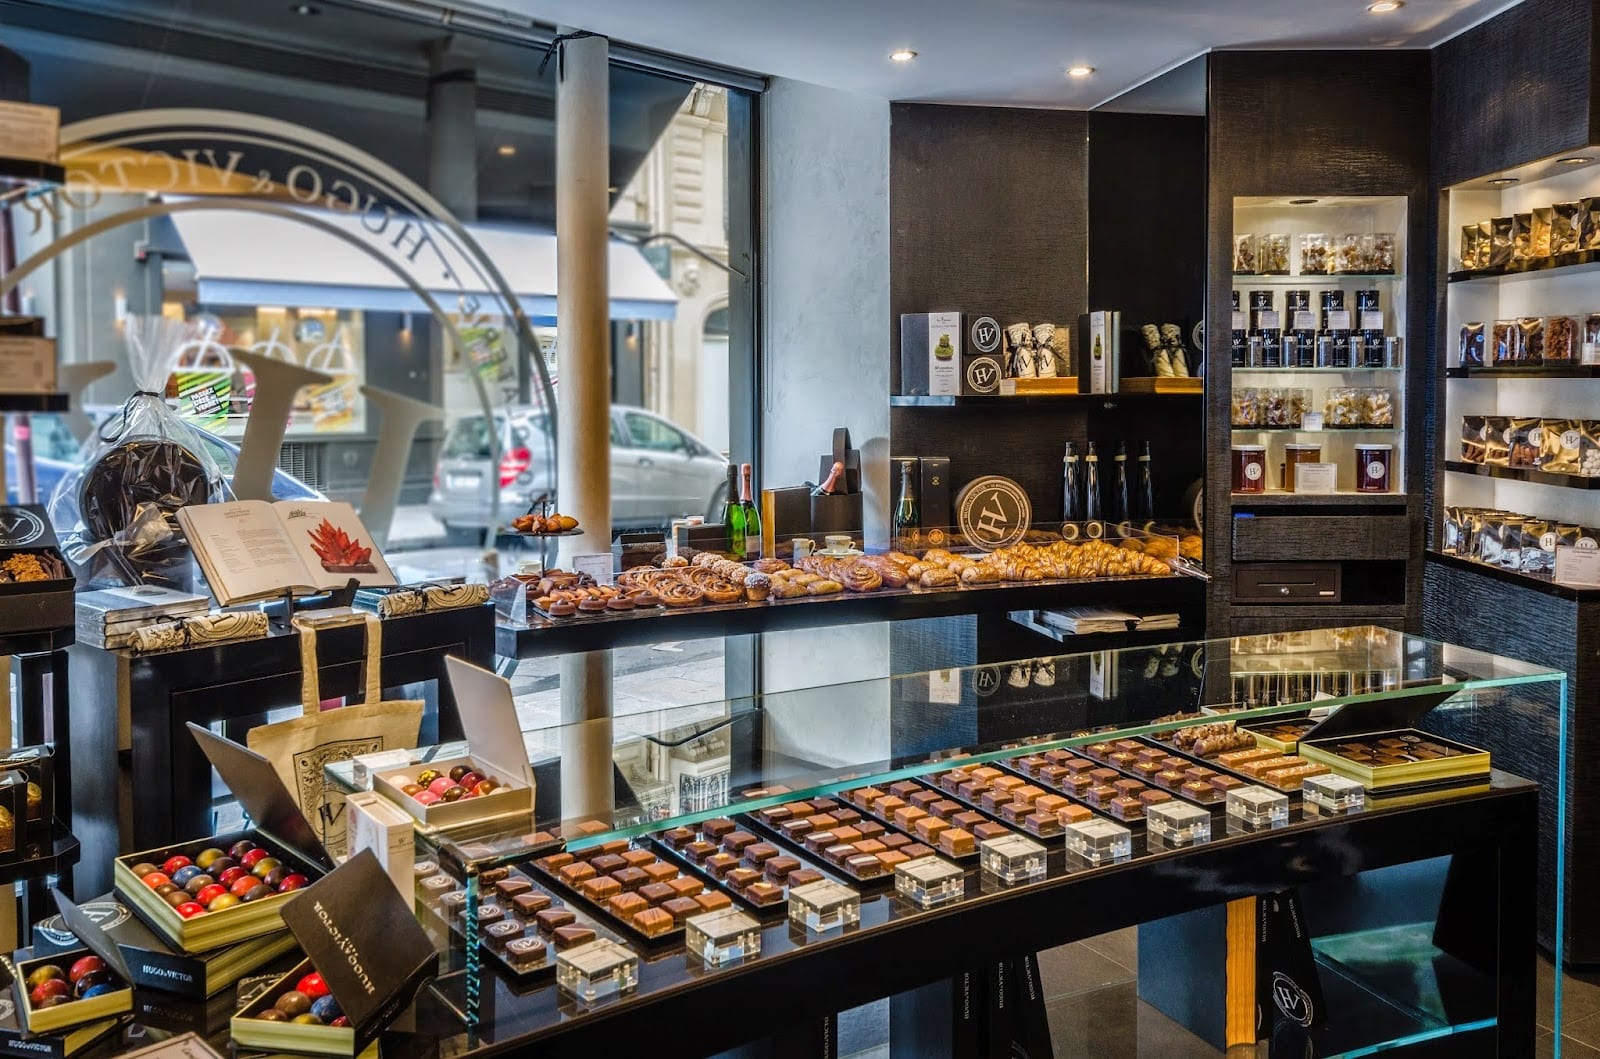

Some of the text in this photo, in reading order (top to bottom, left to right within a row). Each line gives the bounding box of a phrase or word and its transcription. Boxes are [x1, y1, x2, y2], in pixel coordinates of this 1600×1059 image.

[978, 327, 994, 344] HV
[974, 367, 994, 385] HV
[977, 492, 1008, 539] HV
[1276, 986, 1301, 1010] HV
